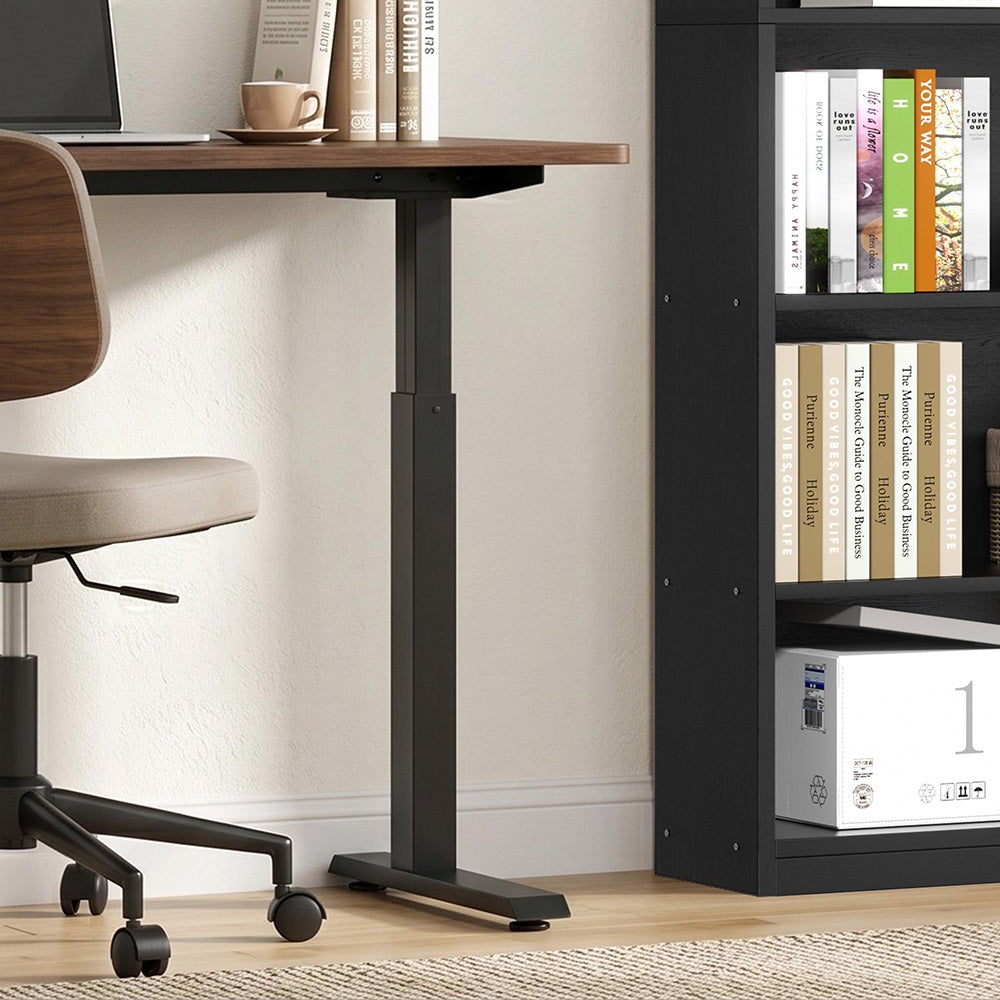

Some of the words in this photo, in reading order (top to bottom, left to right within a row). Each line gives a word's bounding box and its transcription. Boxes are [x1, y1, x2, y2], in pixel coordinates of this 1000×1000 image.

[863, 91, 881, 105] life
[920, 78, 933, 126] YOUR
[863, 125, 881, 153] flower
[920, 130, 933, 166] WAY
[893, 100, 908, 270] HOME
[854, 367, 864, 387] The
[902, 366, 912, 386] The
[946, 374, 956, 417] GOOD
[782, 378, 792, 421] GOOD
[829, 377, 839, 420] GOOD
[854, 391, 864, 435] Monocle
[878, 393, 889, 447] Purienne
[902, 389, 912, 433] Monocle
[924, 392, 935, 446] Purienne
[806, 395, 818, 449] Purienne
[854, 437, 864, 468] Guide
[902, 436, 912, 467] Guide
[829, 473, 839, 516] GOOD
[854, 471, 864, 482] to
[902, 469, 912, 480] to
[946, 470, 956, 513] GOOD
[782, 475, 792, 518] GOOD
[803, 479, 819, 527] Holiday
[854, 484, 864, 513] Good
[875, 477, 889, 525] Holiday
[902, 483, 912, 511] Good
[921, 476, 935, 523] Holiday
[782, 524, 792, 556] LIFE
[829, 523, 839, 554] LIFE
[854, 516, 864, 559] Business
[902, 514, 912, 558] Business
[946, 519, 956, 549] LIFE
[955, 680, 984, 755] 1
